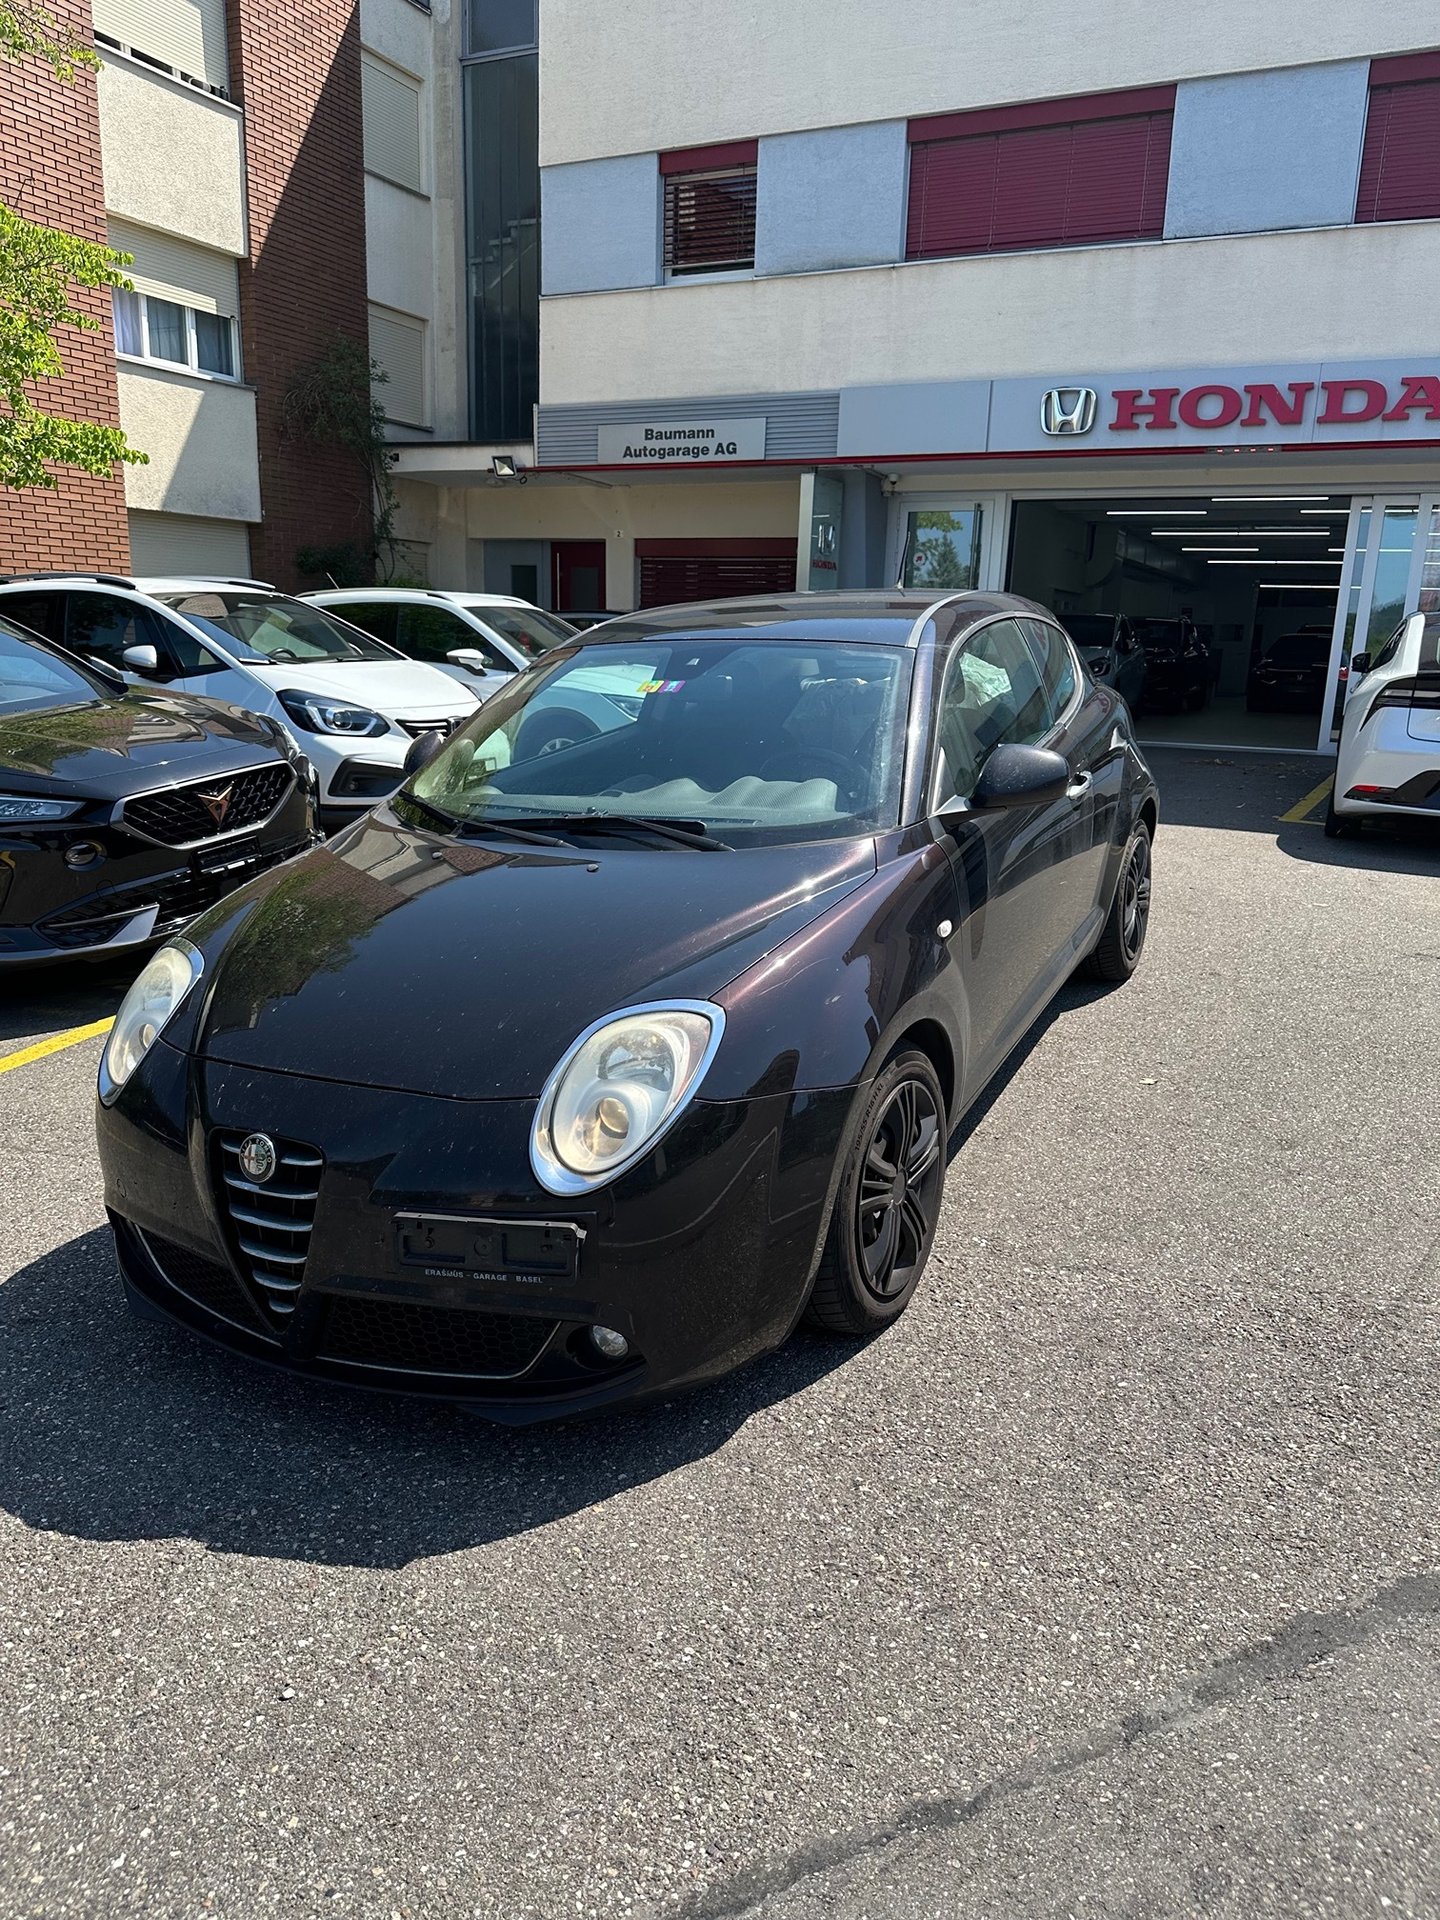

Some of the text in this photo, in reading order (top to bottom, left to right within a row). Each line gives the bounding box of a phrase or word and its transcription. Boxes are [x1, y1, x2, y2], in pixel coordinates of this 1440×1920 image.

[1108, 376, 1440, 431] HONDA
[644, 428, 715, 441] Baumann
[622, 442, 738, 459] Autogarage AG
[473, 1272, 507, 1281] GARAGE
[515, 1275, 543, 1284] BASEL
